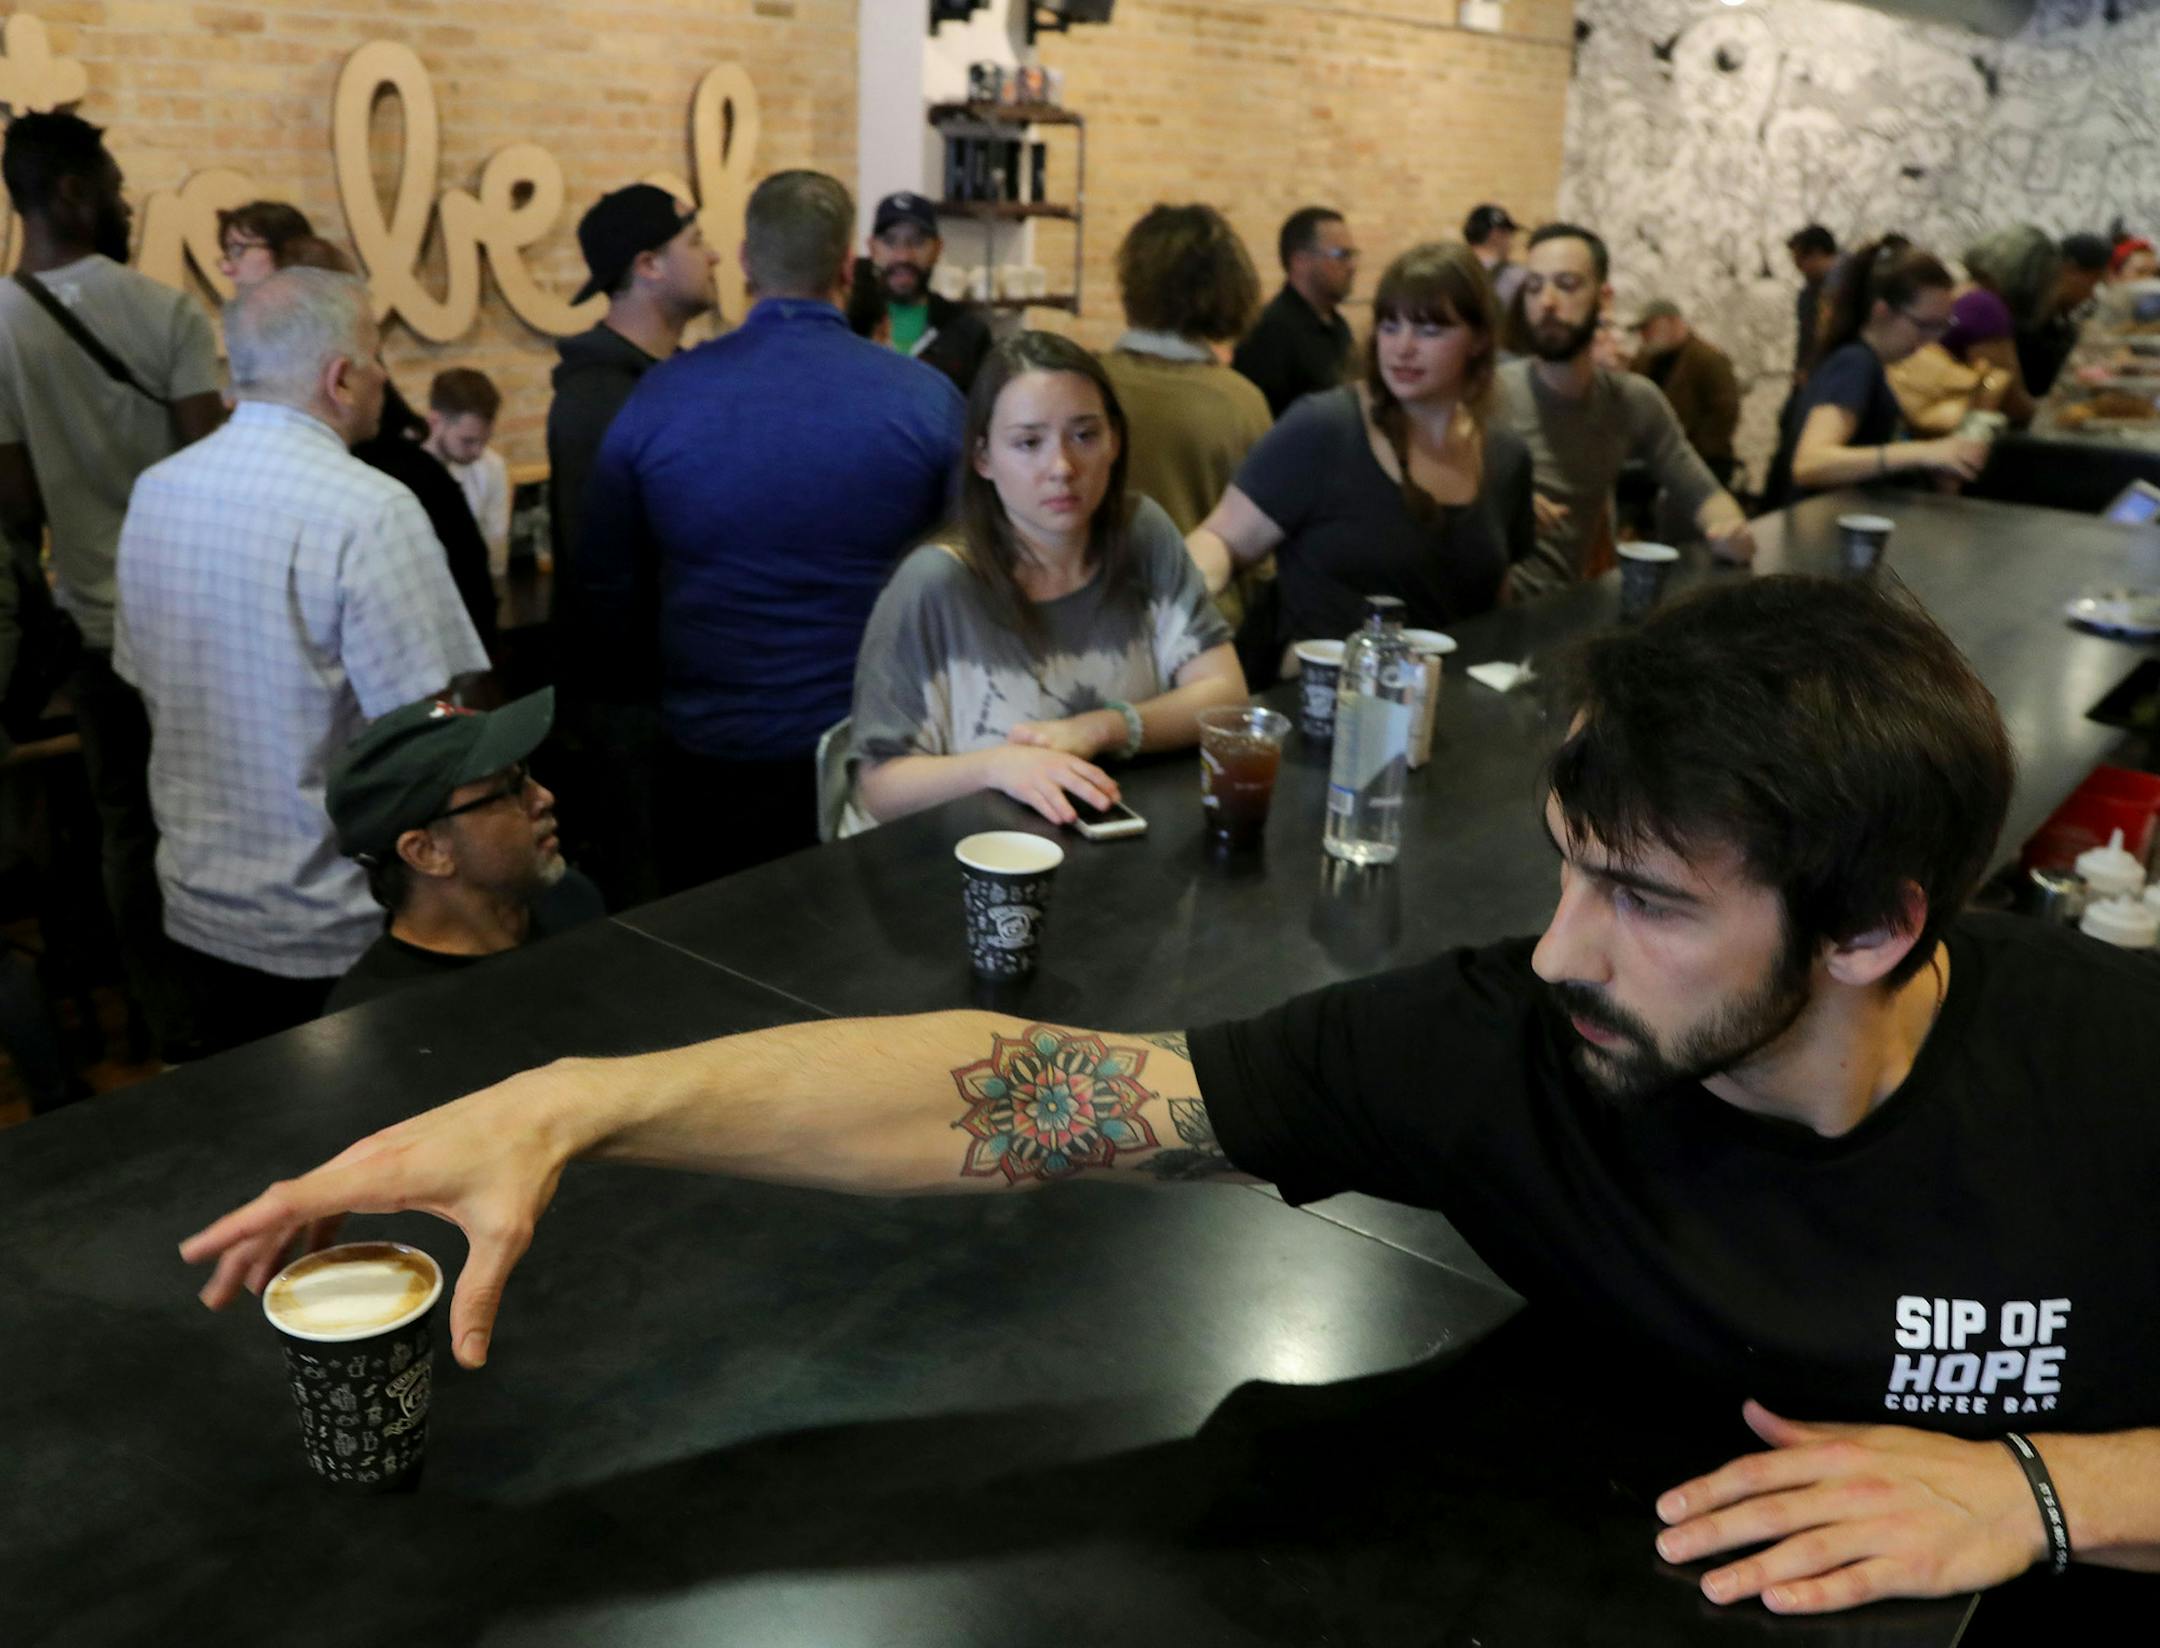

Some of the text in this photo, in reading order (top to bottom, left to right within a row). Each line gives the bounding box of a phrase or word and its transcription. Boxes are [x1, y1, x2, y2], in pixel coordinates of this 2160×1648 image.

[1895, 1295, 2072, 1350] SIP OF
[1888, 1345, 2067, 1395] HOPE
[1884, 1393, 2057, 1414] COFFEE BAR
